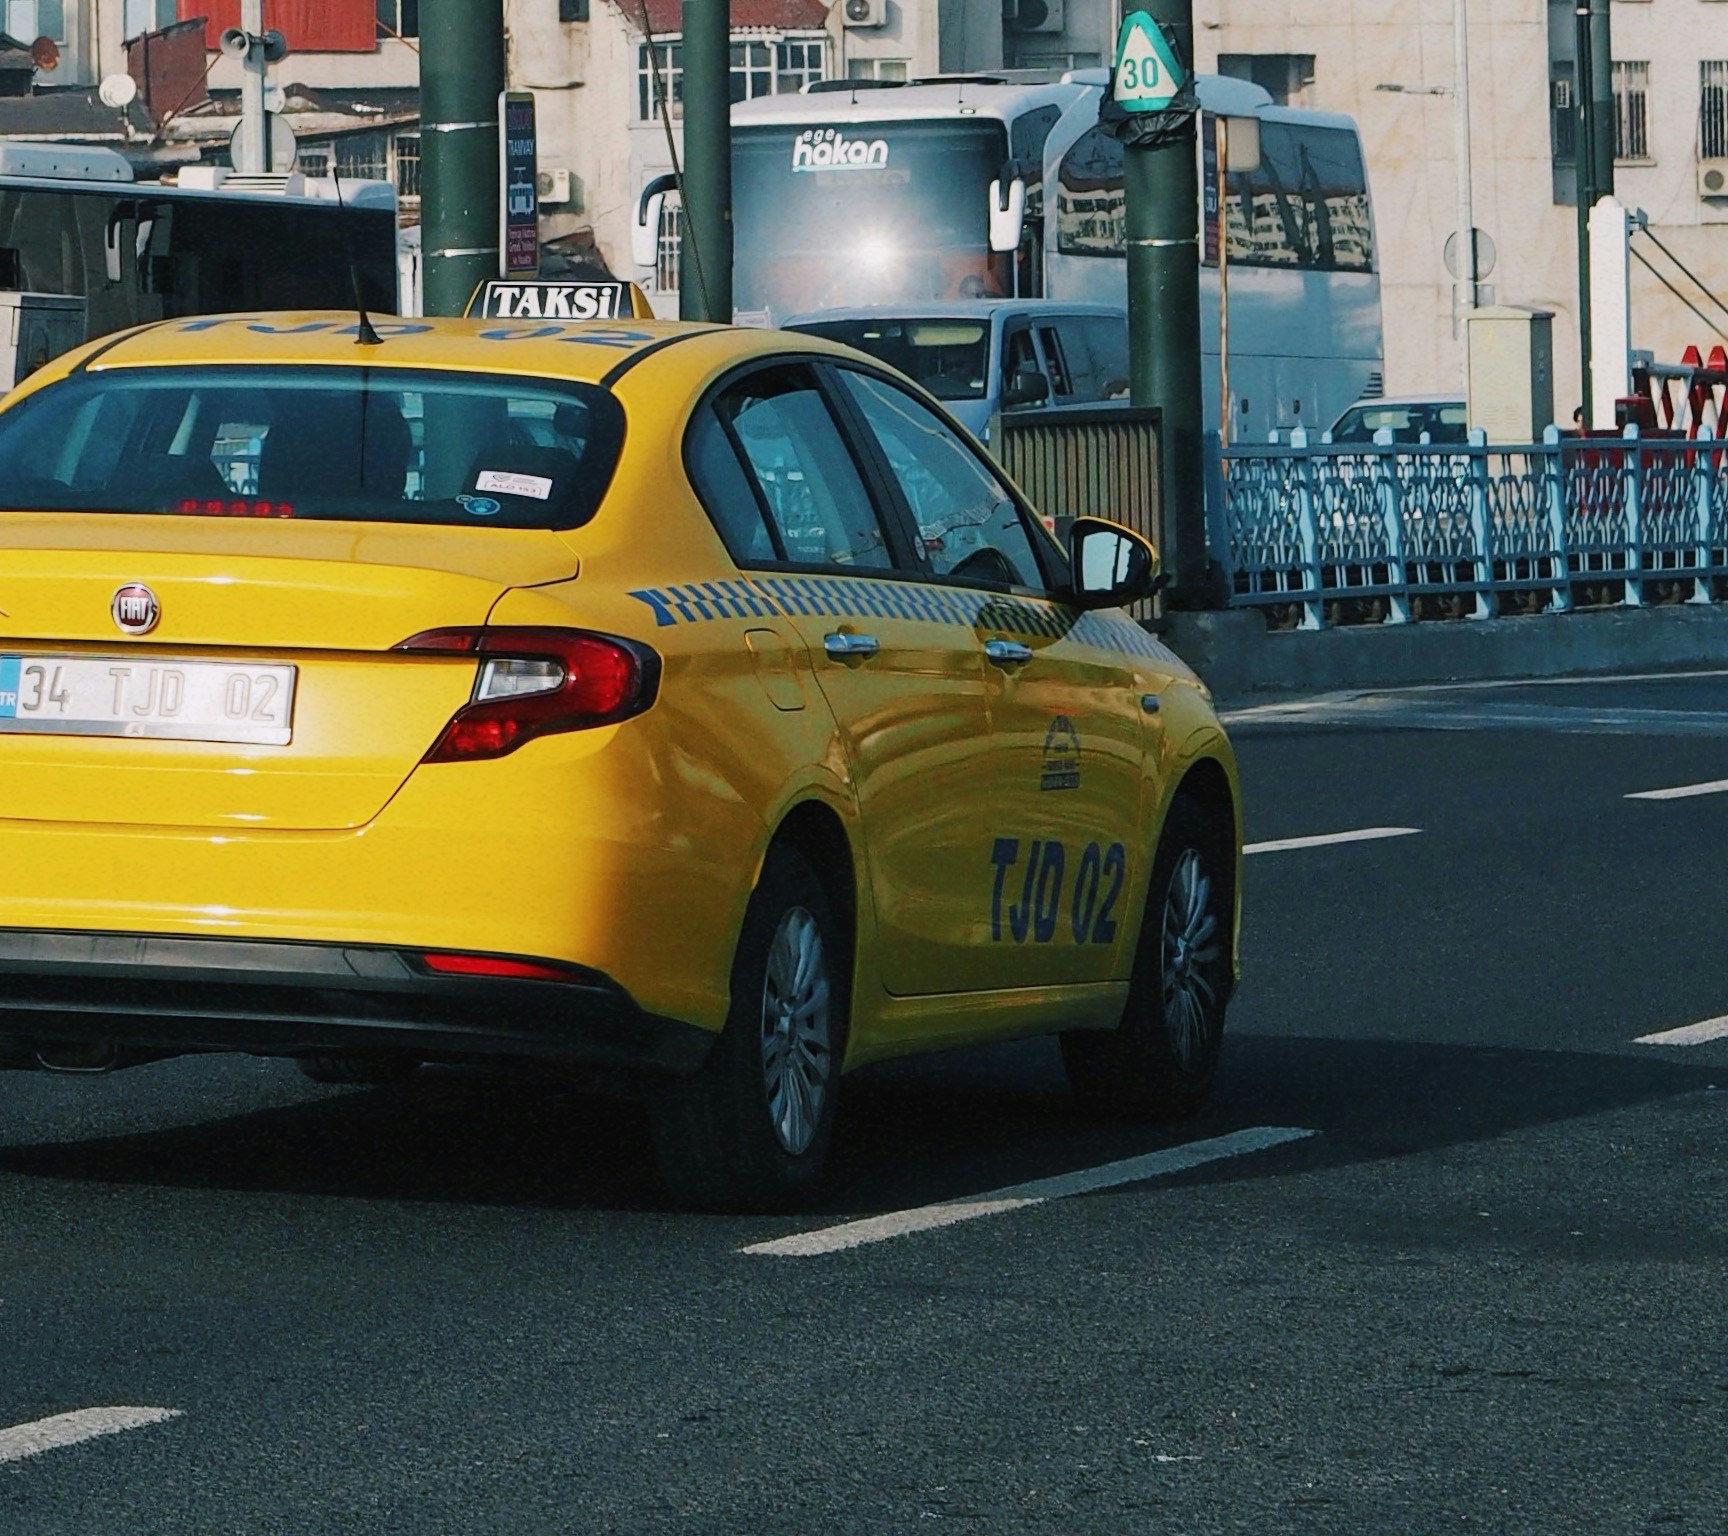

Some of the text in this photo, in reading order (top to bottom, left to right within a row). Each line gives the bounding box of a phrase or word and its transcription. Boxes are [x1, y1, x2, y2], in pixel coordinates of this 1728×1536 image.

[1124, 57, 1159, 90] 30
[793, 132, 888, 167] hakan
[803, 128, 835, 144] ege
[479, 326, 656, 349] 02
[120, 597, 149, 620] FIAT
[22, 666, 279, 722] 34 TJD 02
[991, 837, 1126, 946] TJD 02
